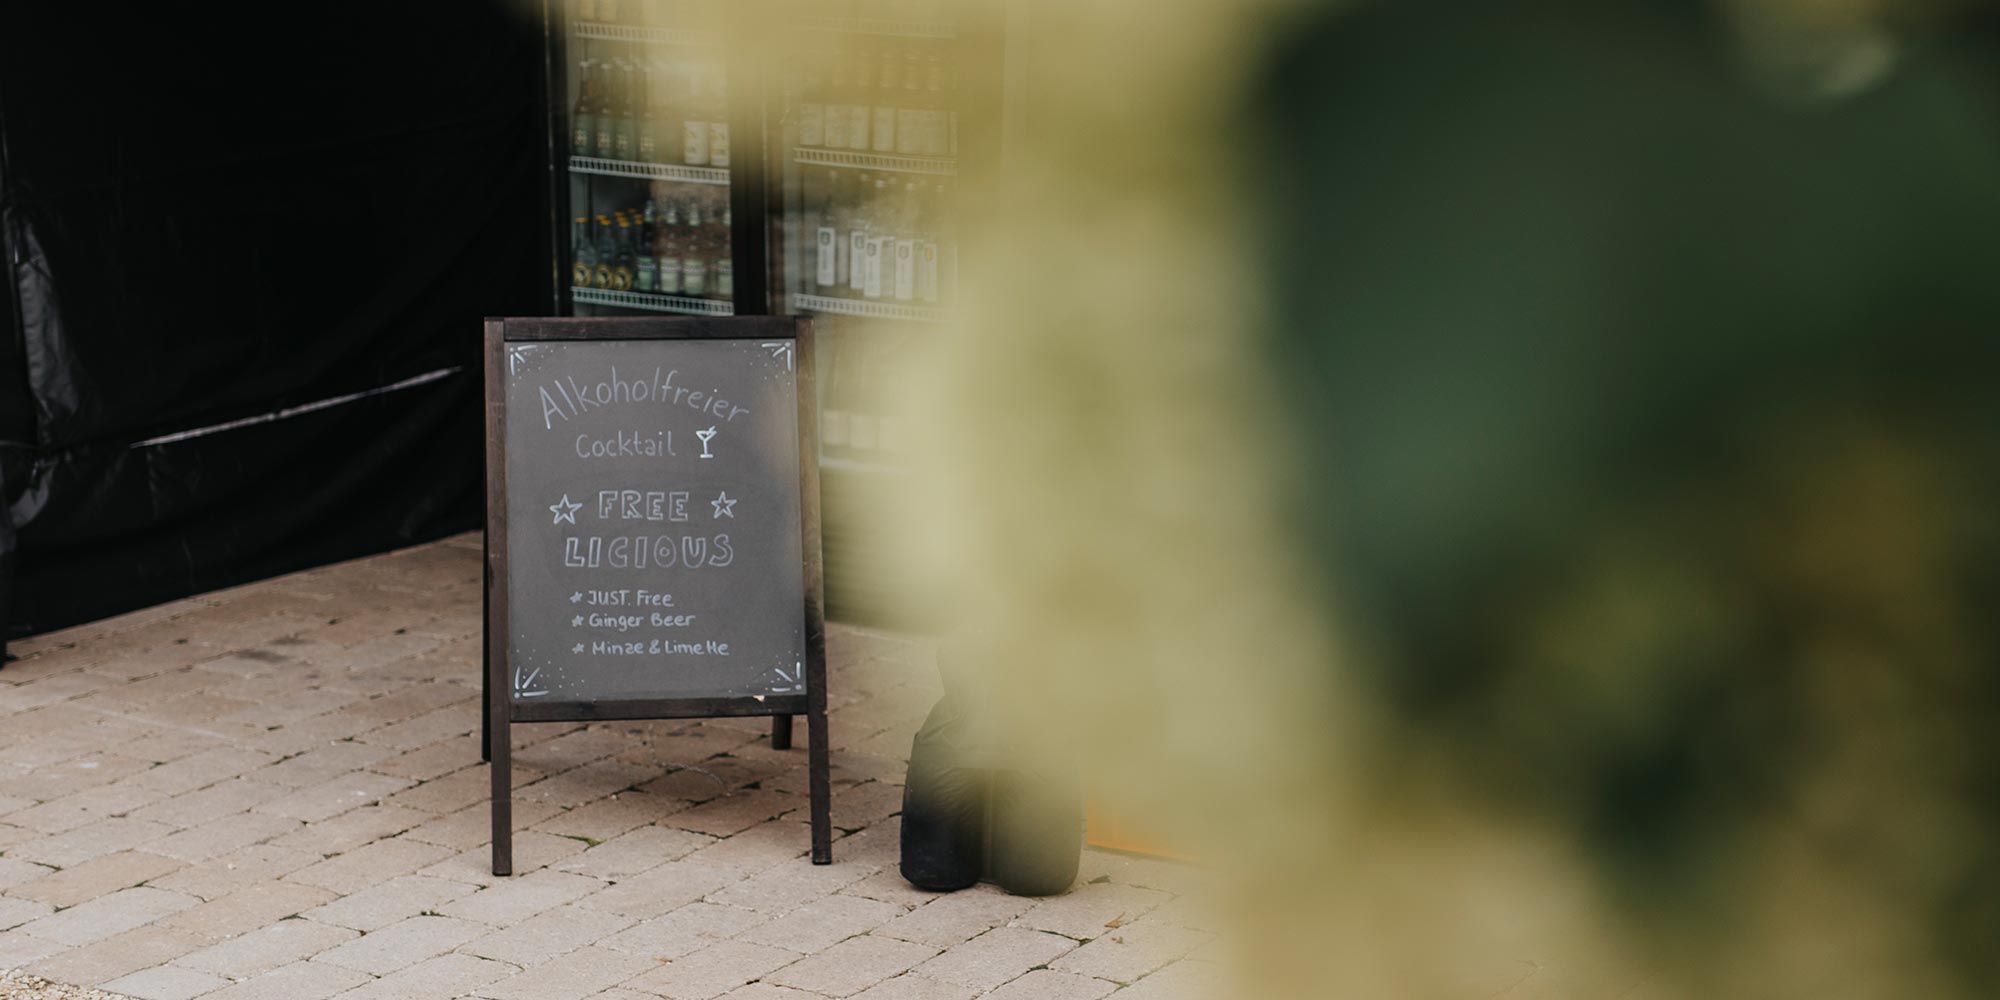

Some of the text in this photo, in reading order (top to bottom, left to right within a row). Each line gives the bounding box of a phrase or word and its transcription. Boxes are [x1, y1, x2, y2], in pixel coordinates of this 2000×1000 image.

[539, 365, 749, 430] Alkoholfreier
[575, 430, 677, 459] Cocktail
[599, 489, 690, 522] FREE
[564, 533, 734, 569] LICIOUS
[636, 590, 675, 607] Free
[588, 612, 696, 632] Ginger Beer
[592, 640, 644, 655] Minze
[649, 638, 661, 654] &
